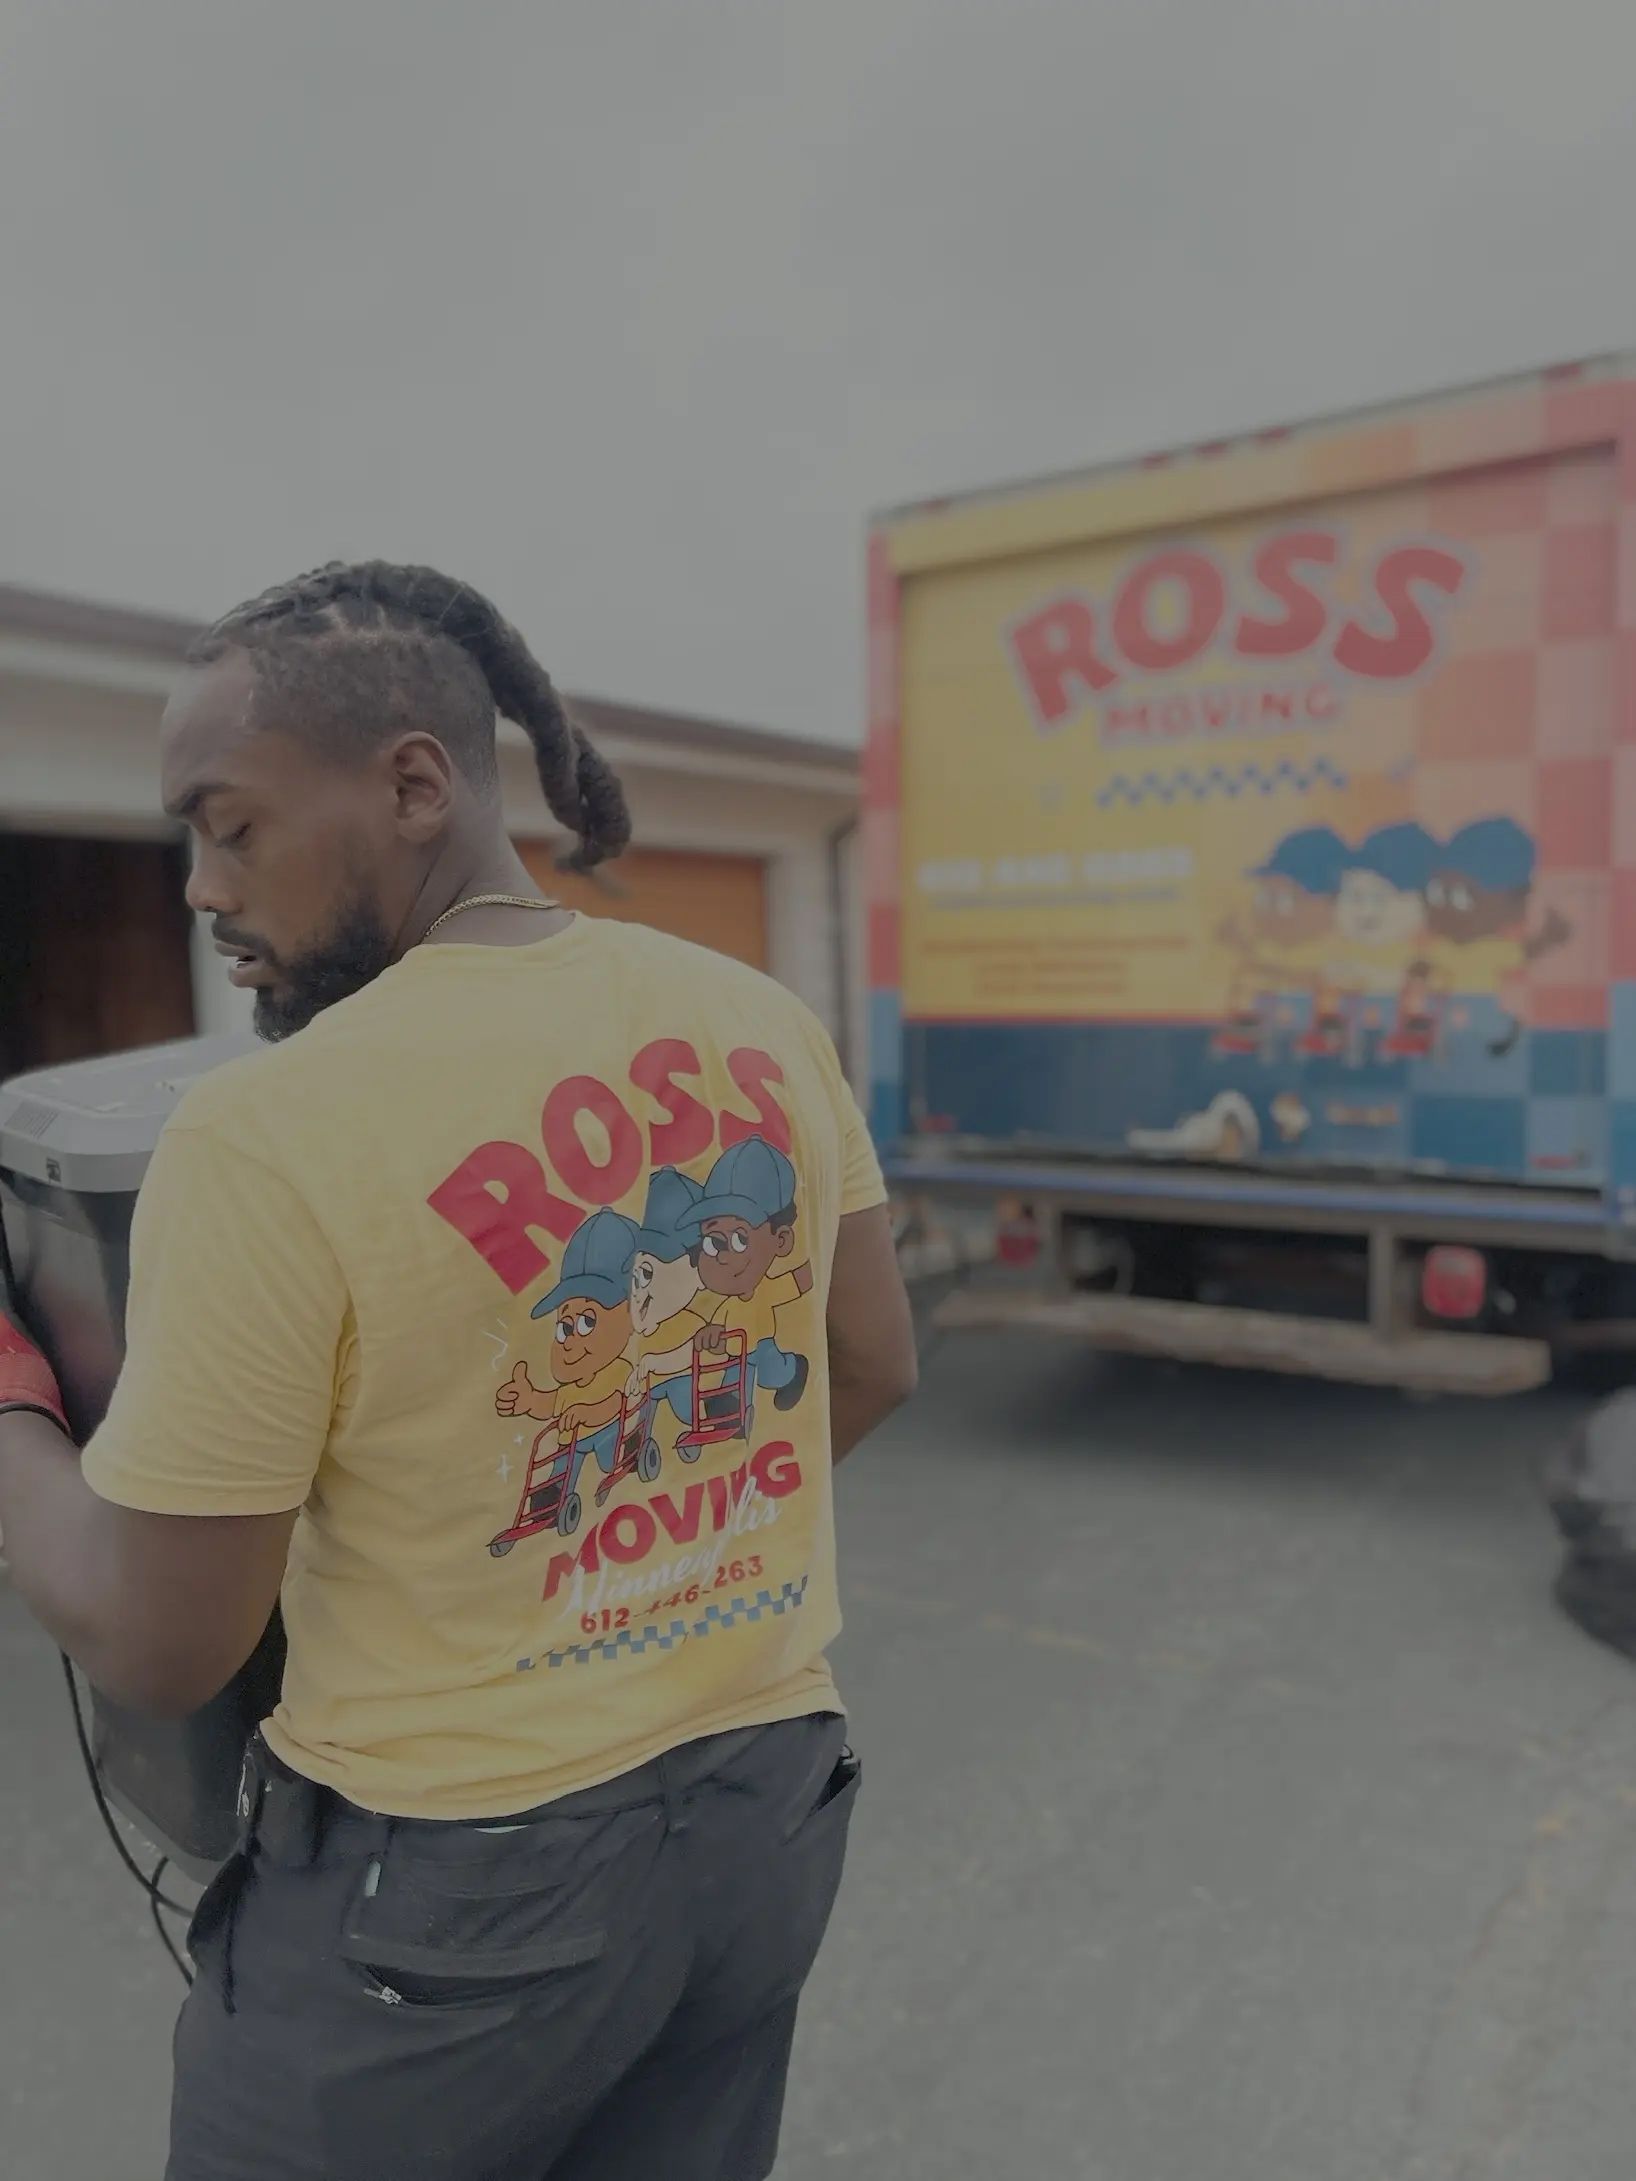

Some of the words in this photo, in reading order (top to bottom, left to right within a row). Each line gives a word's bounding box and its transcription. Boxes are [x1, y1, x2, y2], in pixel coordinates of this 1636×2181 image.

[1012, 530, 1466, 721] ROSS
[1106, 683, 1336, 736] MOVING
[426, 1038, 793, 1296] ROSS
